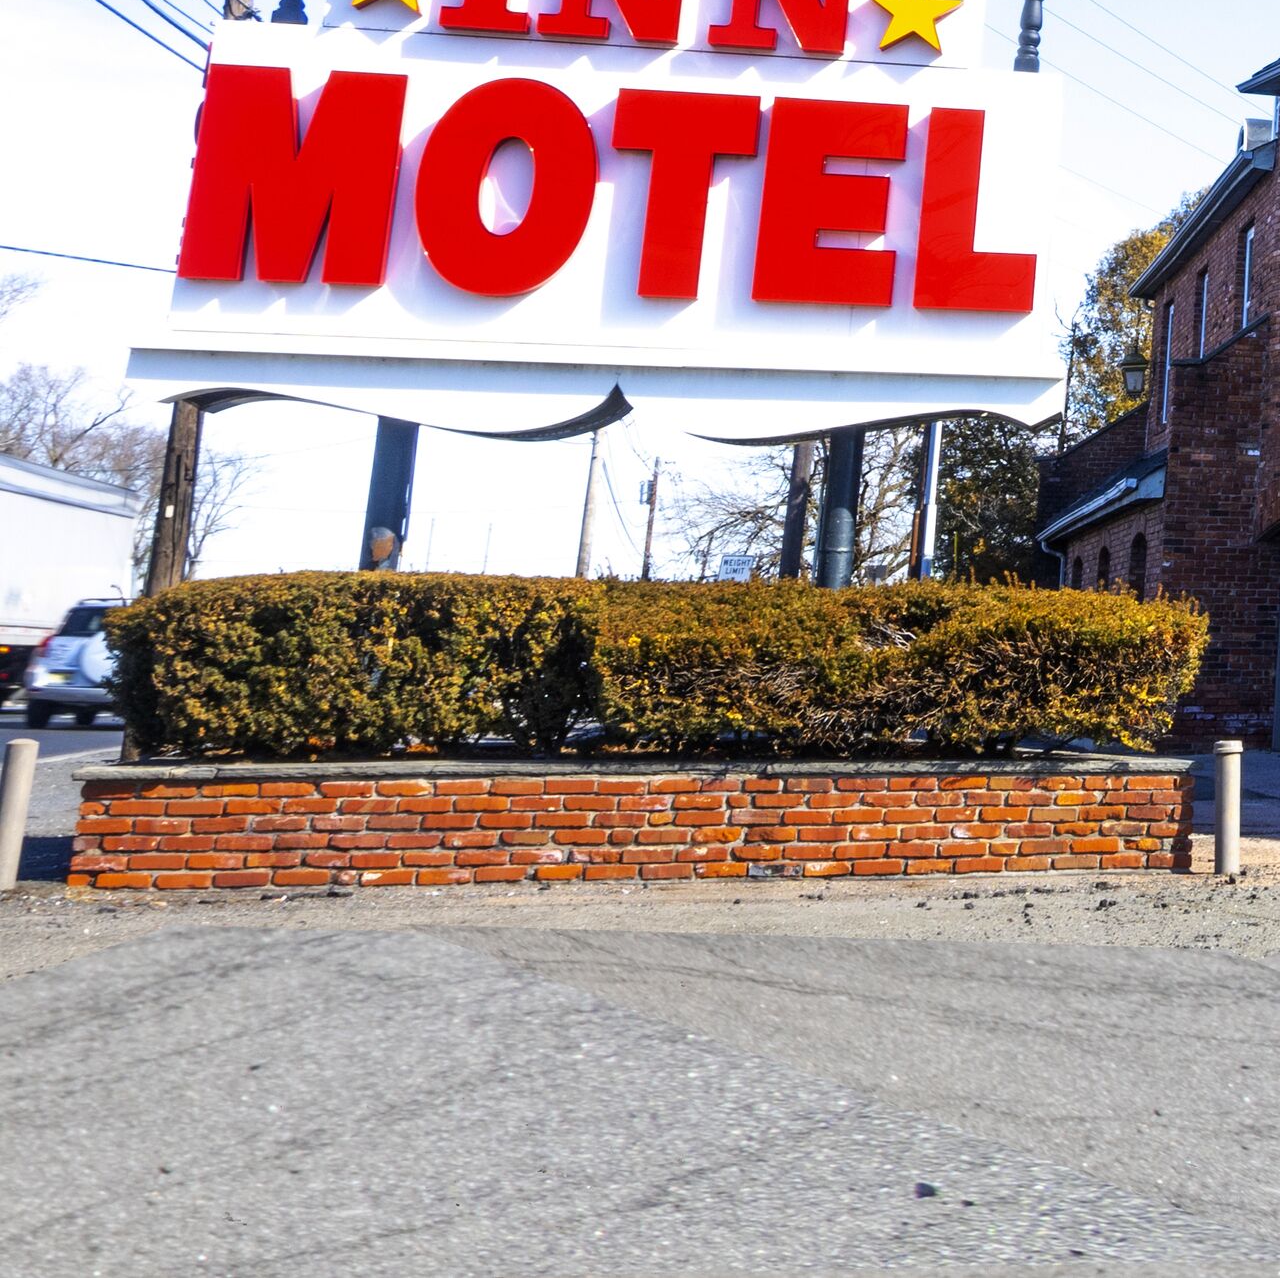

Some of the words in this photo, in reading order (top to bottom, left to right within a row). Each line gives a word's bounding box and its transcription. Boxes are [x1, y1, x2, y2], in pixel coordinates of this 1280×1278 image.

[176, 62, 1038, 313] MOTEL
[723, 559, 751, 567] WEIGHT
[725, 567, 745, 575] LIMIT
